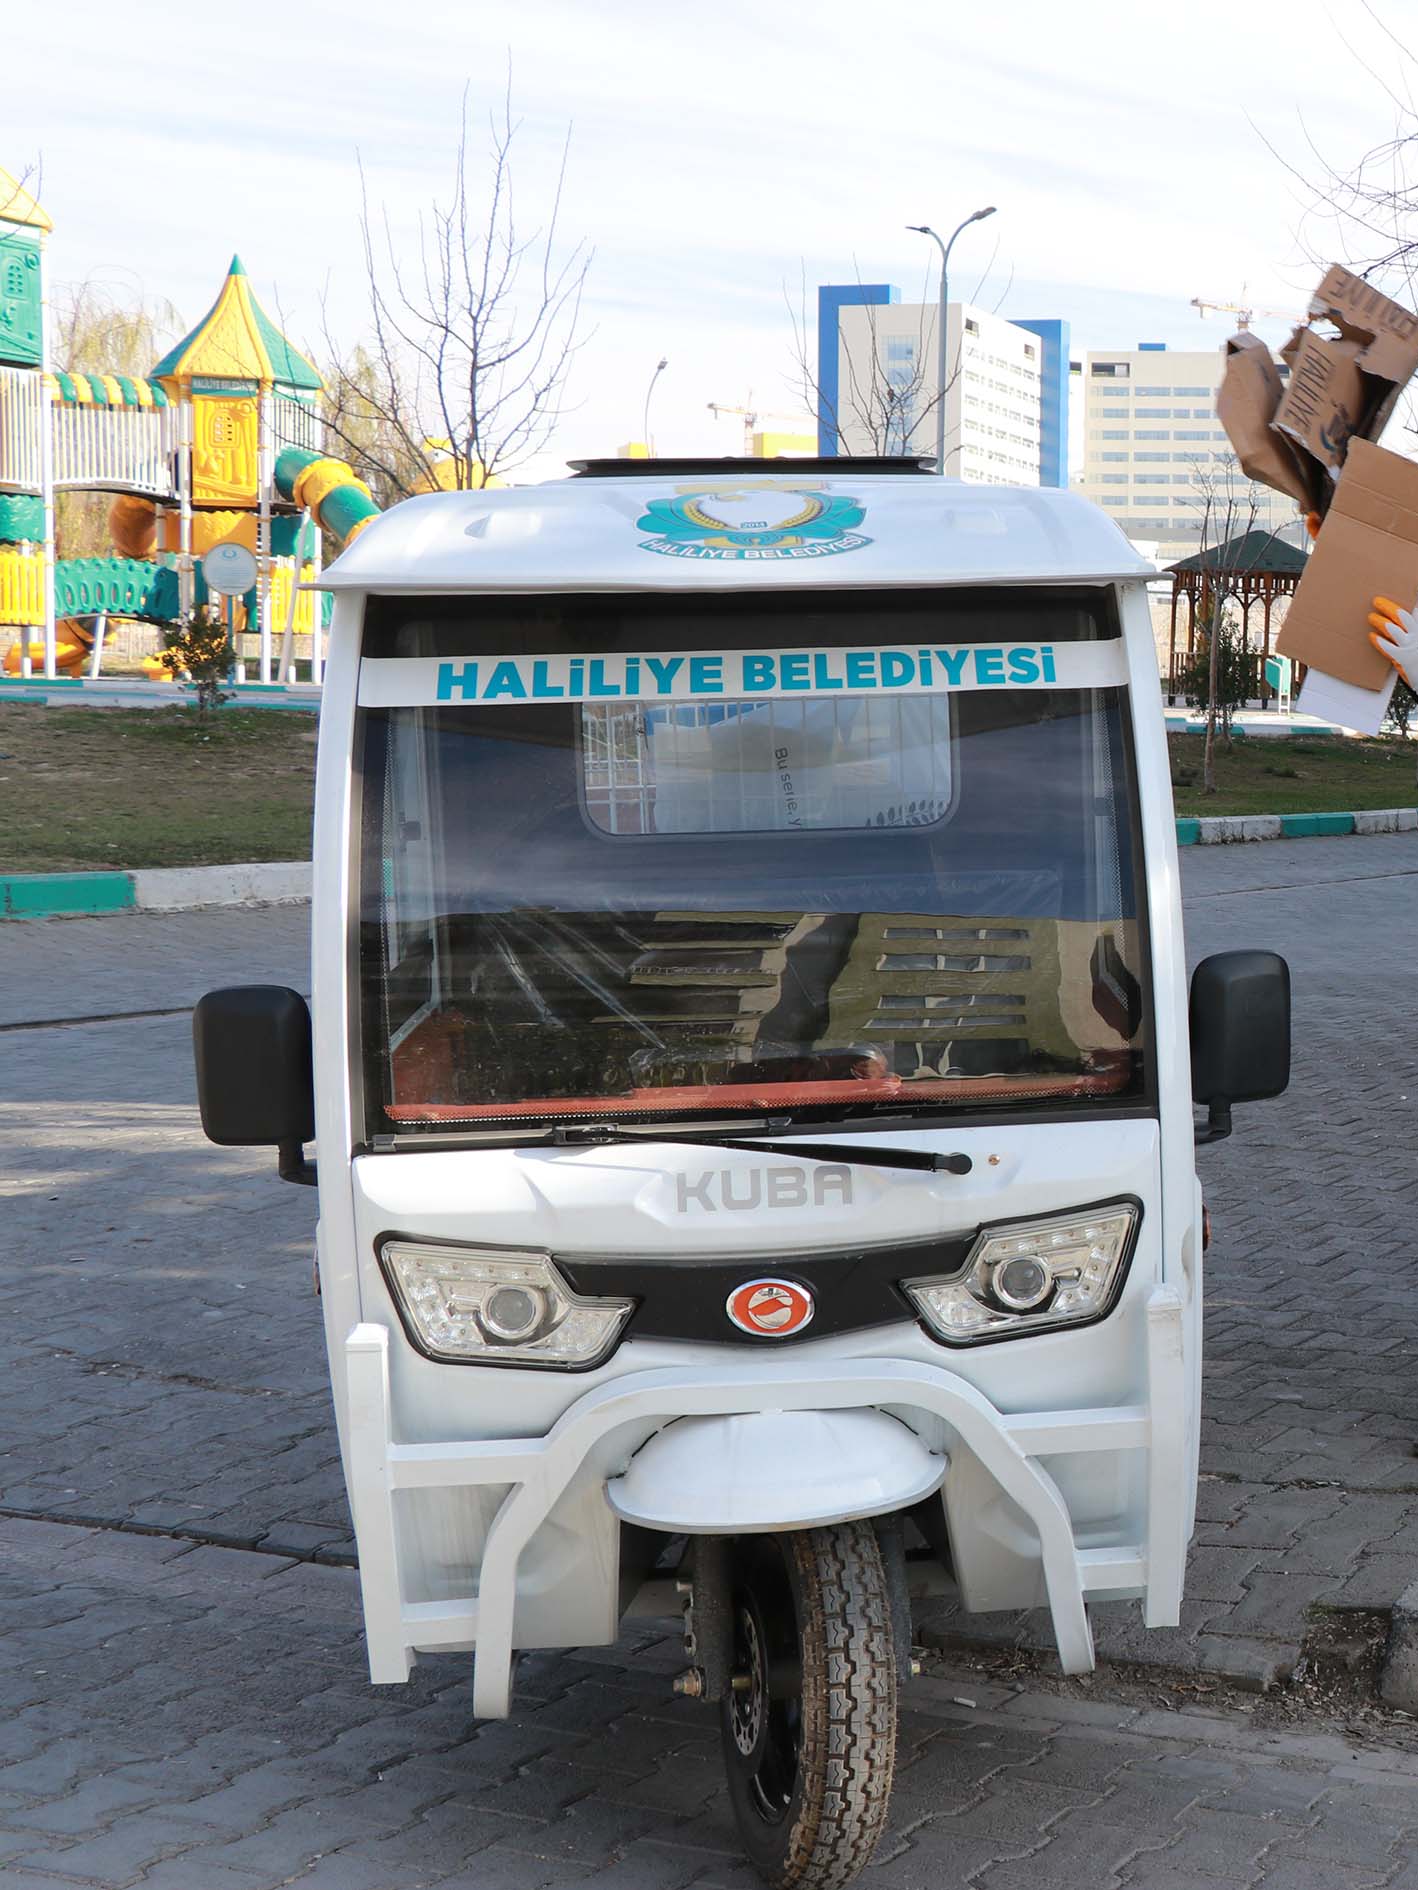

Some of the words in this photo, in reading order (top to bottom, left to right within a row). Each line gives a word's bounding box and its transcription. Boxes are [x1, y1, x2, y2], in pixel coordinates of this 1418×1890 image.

[645, 539, 736, 559] HALİLİYE
[744, 533, 865, 559] BELEDİYESİ
[436, 656, 724, 700] HALİLİYE
[742, 646, 1057, 692] BELEDİYESİ
[676, 1164, 852, 1213] KUBA
